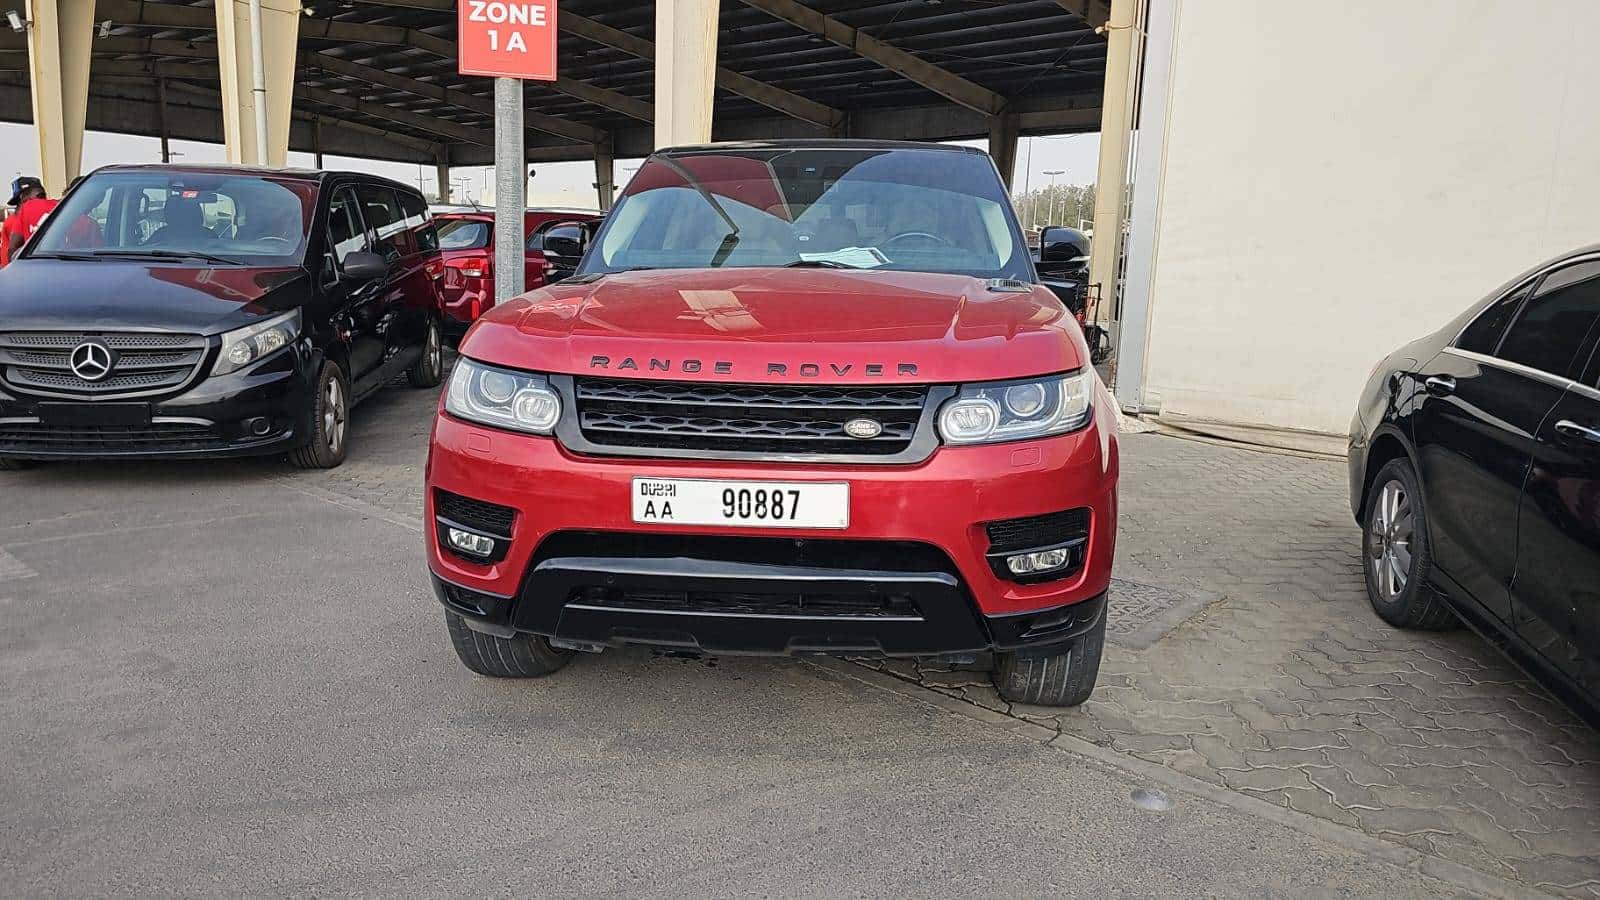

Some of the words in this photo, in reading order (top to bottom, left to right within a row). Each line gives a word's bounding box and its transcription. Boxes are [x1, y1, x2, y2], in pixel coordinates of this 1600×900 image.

[469, 1, 546, 26] ZONE
[590, 355, 733, 374] RANGE
[767, 363, 918, 376] ROVER
[644, 500, 674, 519] AA
[722, 488, 800, 520] 90887
